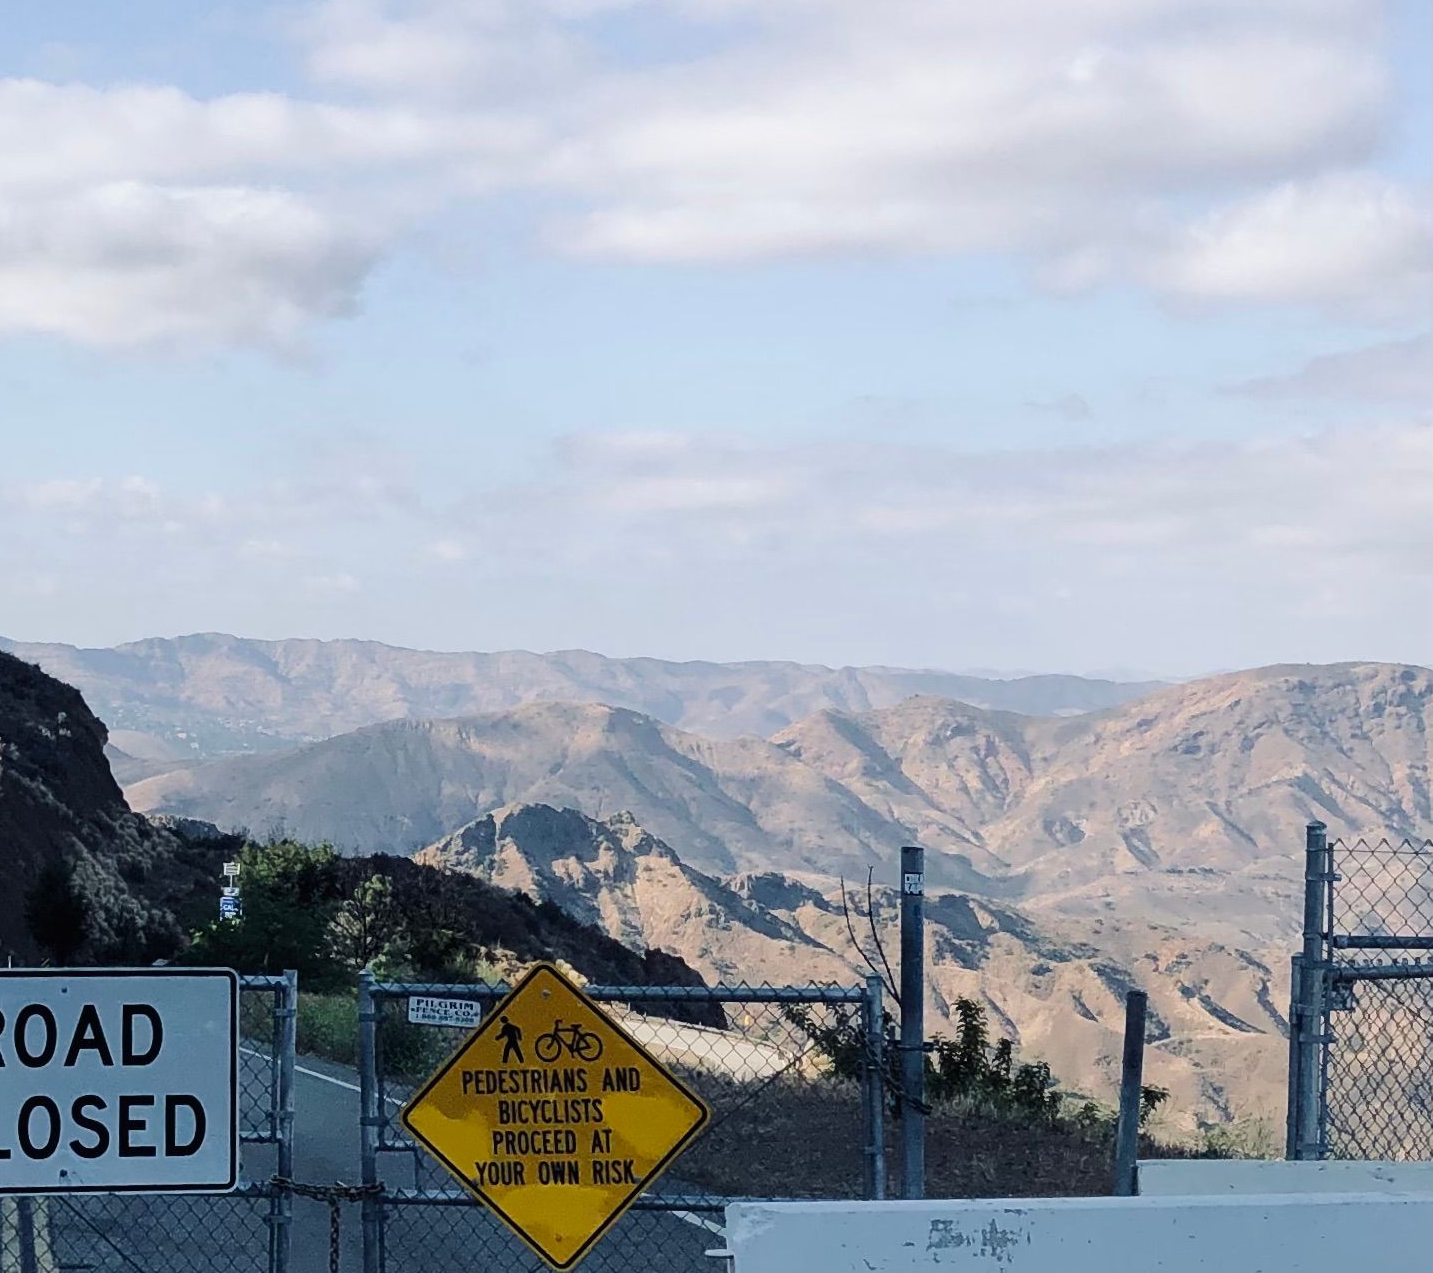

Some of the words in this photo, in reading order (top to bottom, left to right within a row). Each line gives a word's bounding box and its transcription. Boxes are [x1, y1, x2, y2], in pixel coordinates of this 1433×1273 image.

[416, 998, 474, 1011] PILGRIM
[461, 1068, 588, 1095] PEDESTRIANS
[601, 1067, 641, 1092] AND
[498, 1098, 604, 1125] BICYCLISTS
[492, 1129, 577, 1155] PROCEED
[590, 1128, 613, 1154] AT
[474, 1161, 526, 1186] YOUR
[538, 1160, 580, 1186] OWN
[592, 1159, 637, 1185] RISK
